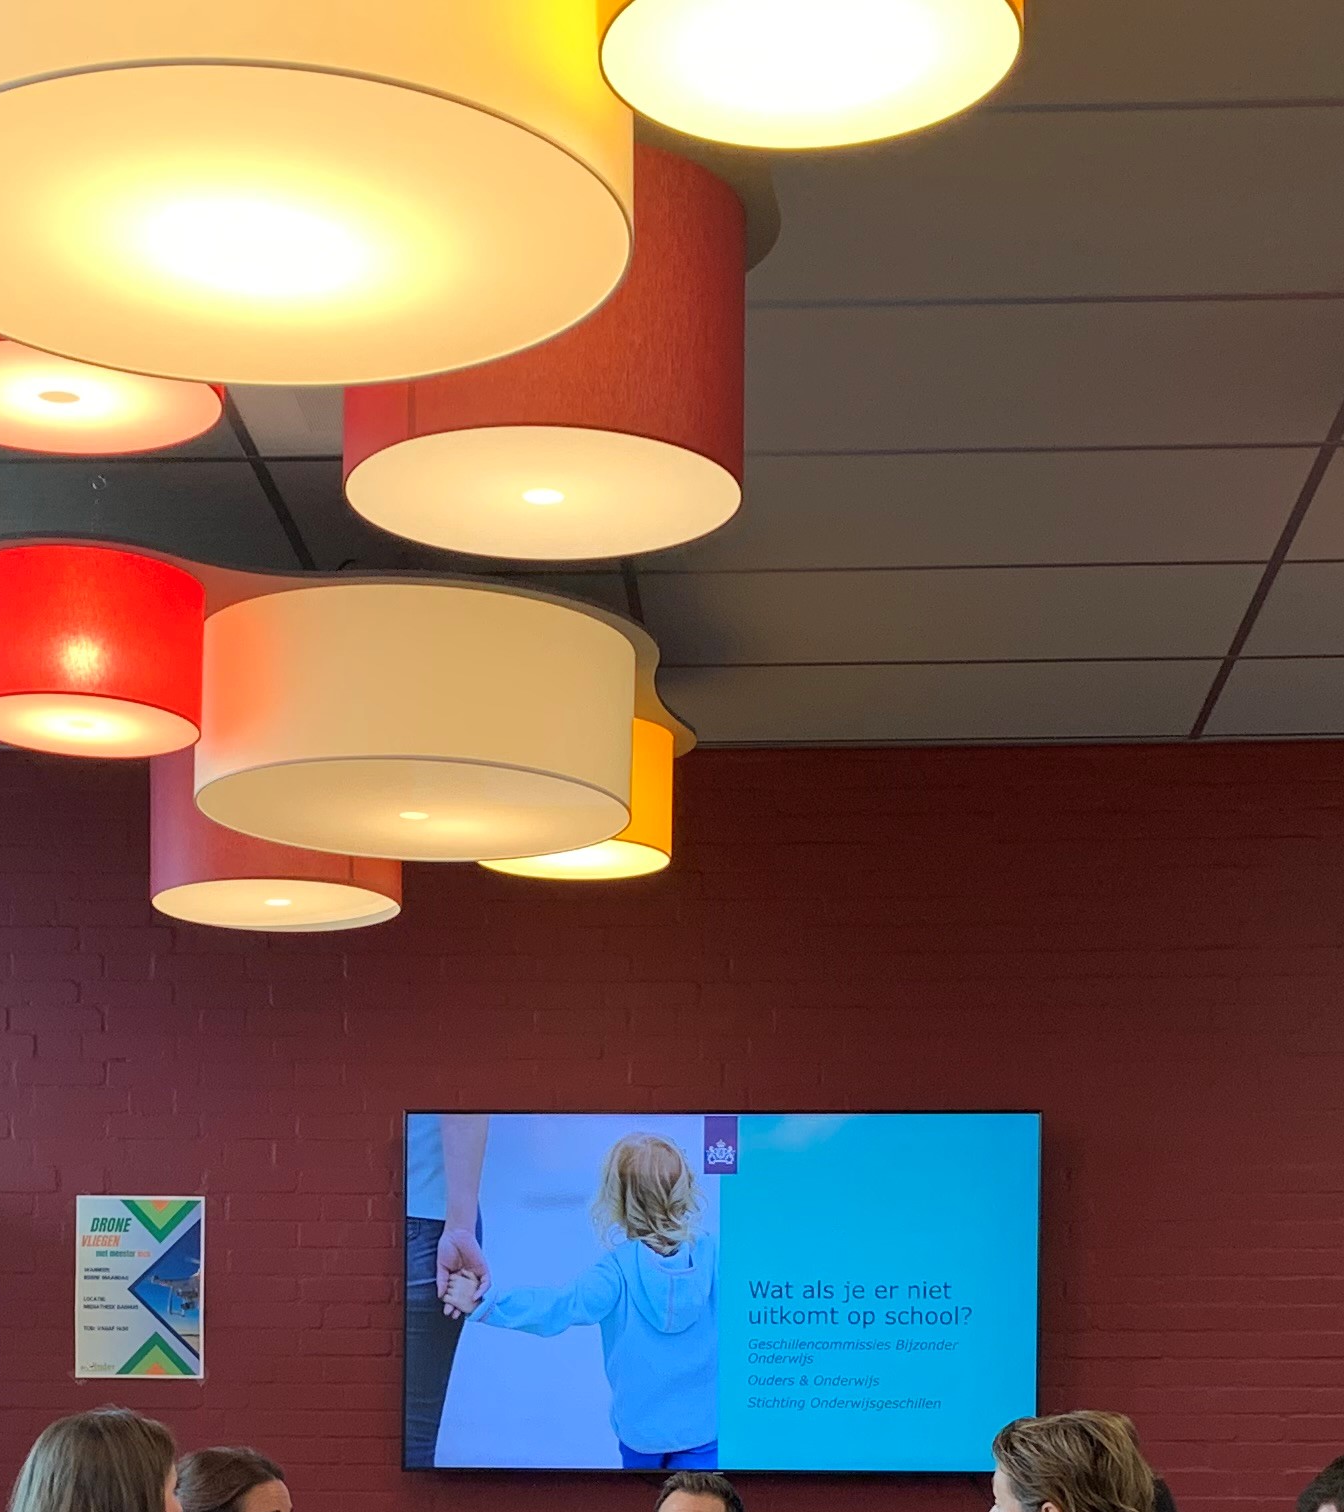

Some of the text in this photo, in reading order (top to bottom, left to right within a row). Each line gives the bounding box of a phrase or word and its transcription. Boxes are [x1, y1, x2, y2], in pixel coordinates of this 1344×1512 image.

[90, 1218, 132, 1232] DRONE
[81, 1235, 120, 1247] VLIEGEN
[749, 1280, 952, 1303] Wat als je er niet
[749, 1306, 973, 1328] uitkomt op school?
[748, 1338, 959, 1353] Geschillencommissies Bijzonder
[748, 1352, 814, 1366] Onderwijs
[748, 1375, 880, 1388] Ouders & Onderwijs
[747, 1397, 942, 1411] Stichting Onderwijsgeschillen
